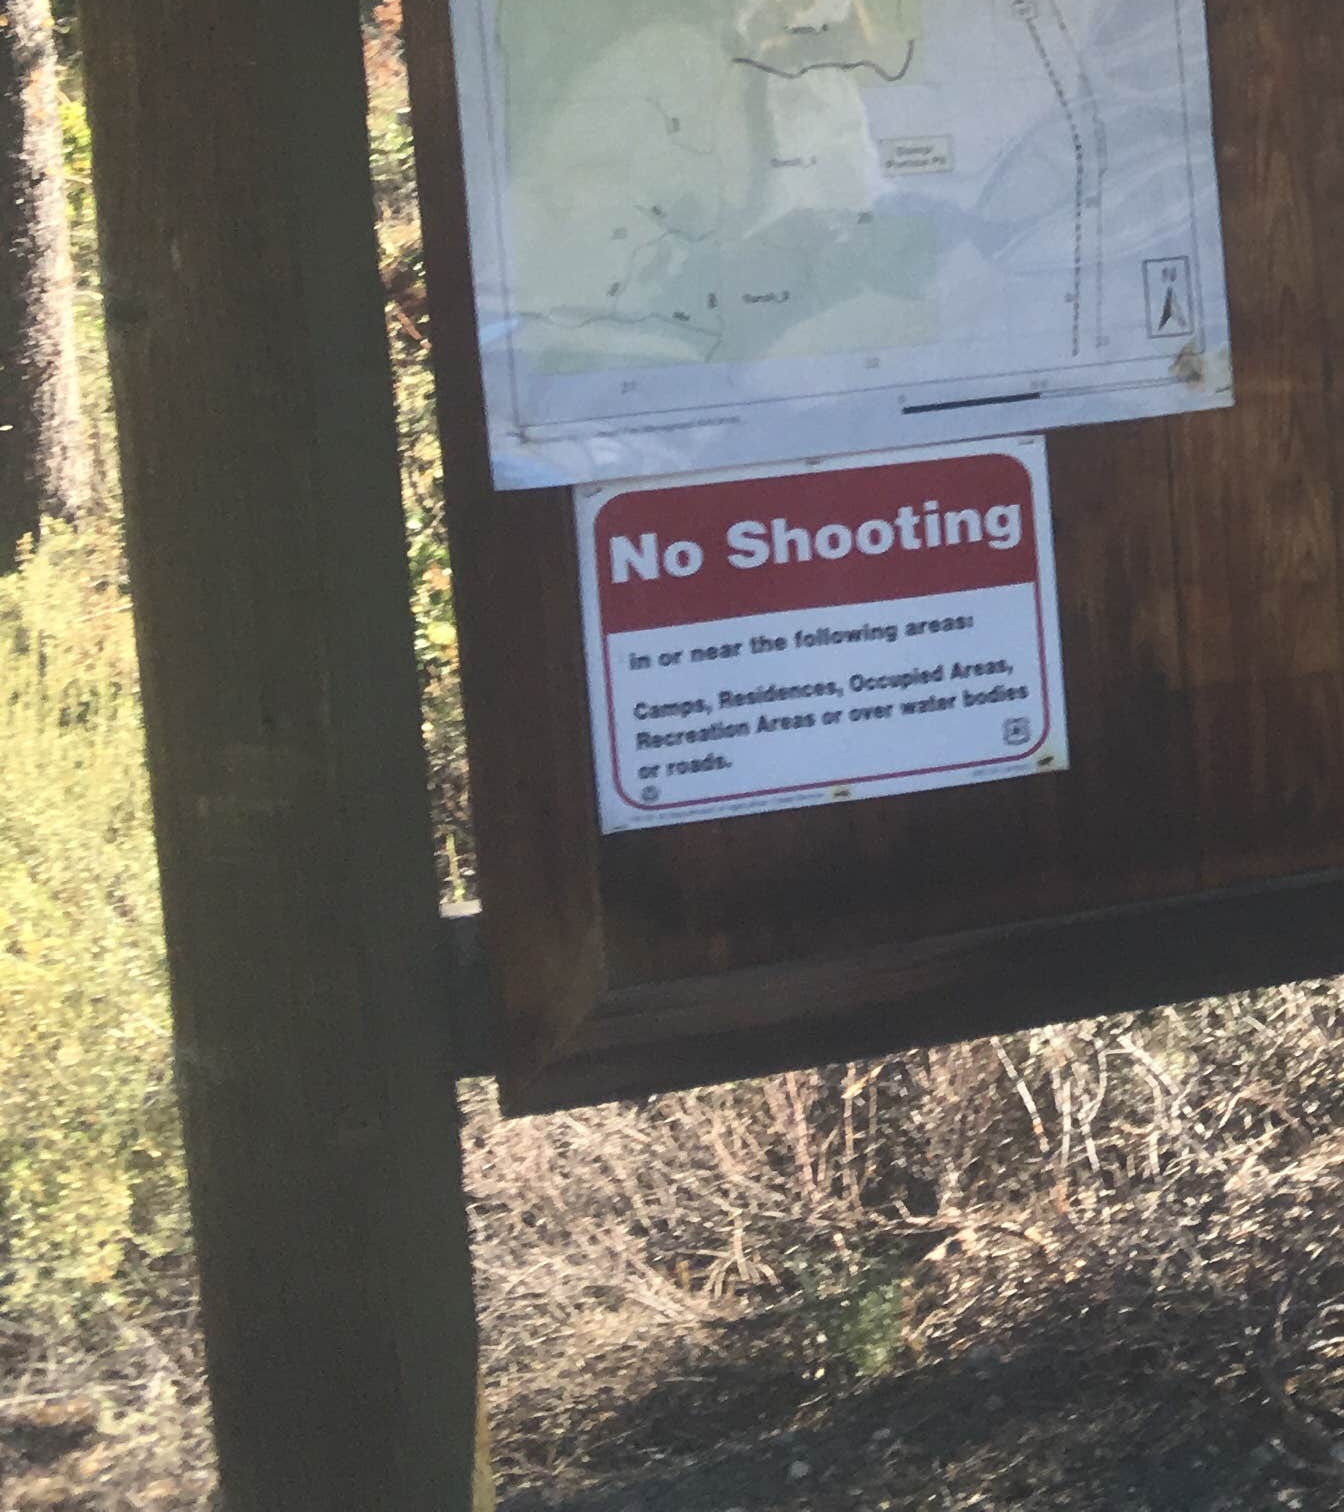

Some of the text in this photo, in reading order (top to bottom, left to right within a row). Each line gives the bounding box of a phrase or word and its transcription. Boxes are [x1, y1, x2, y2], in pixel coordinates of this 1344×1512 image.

[1161, 267, 1177, 282] N
[609, 499, 1024, 584] No Shooting
[658, 649, 682, 668] or
[690, 640, 743, 664] near
[750, 633, 788, 655] the
[793, 620, 899, 650] following
[905, 615, 974, 638] areas:
[633, 656, 1014, 722] Camps, Residences, Occupied Areas,
[635, 684, 1030, 750] Recreation Areas or over water bodies
[638, 753, 734, 780] or roads.
